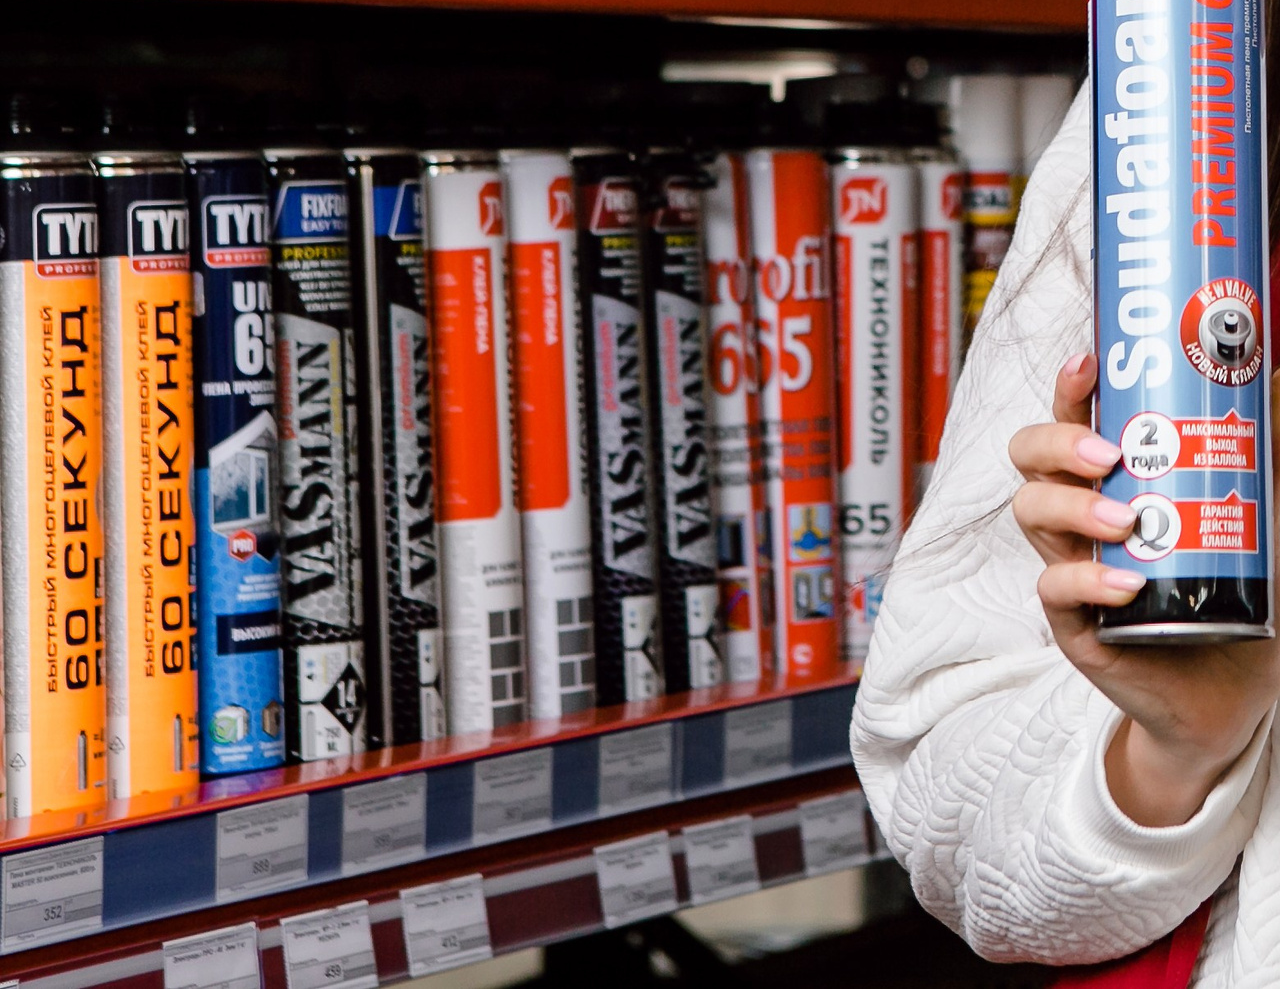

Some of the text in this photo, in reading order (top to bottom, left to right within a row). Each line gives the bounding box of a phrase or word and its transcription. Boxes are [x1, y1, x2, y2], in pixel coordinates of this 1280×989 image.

[1244, 63, 1252, 134] Пистолетная
[1190, 22, 1237, 248] PREMIUM
[41, 212, 96, 256] TYT
[136, 209, 187, 252] TYT
[210, 204, 267, 245] TYT
[1196, 279, 1257, 308] NEW VALVE
[869, 238, 889, 465] ТЕХНОНИКОЛЬ
[1185, 341, 1264, 385] НОВЫЙ КЛАПАН
[1139, 419, 1159, 446] 2
[1181, 423, 1255, 438] МАКСИМАЛЬНЫЙ
[1206, 439, 1238, 454] ВЫХОД
[1131, 453, 1169, 472] года
[1193, 453, 1248, 468] ИЗ БАЛЛОНА
[39, 306, 58, 694] БЫСТРЫЙ МНОГОЦЕЛЕВОЙ КЛЕЙ
[60, 305, 90, 691] 60 СЕКУНД
[137, 301, 155, 678] БЫСТРЫЙ МНОГОЦЕЛЕВОЙ КЛЕЙ
[155, 300, 185, 675] 60 СЕКУНД
[840, 503, 891, 536] 65
[1199, 519, 1245, 534] ДЕЙСТВИЯ
[1200, 504, 1244, 518] ГАРАНТИЯ
[1202, 533, 1243, 548] КЛАПАНА
[43, 905, 63, 922] 352
